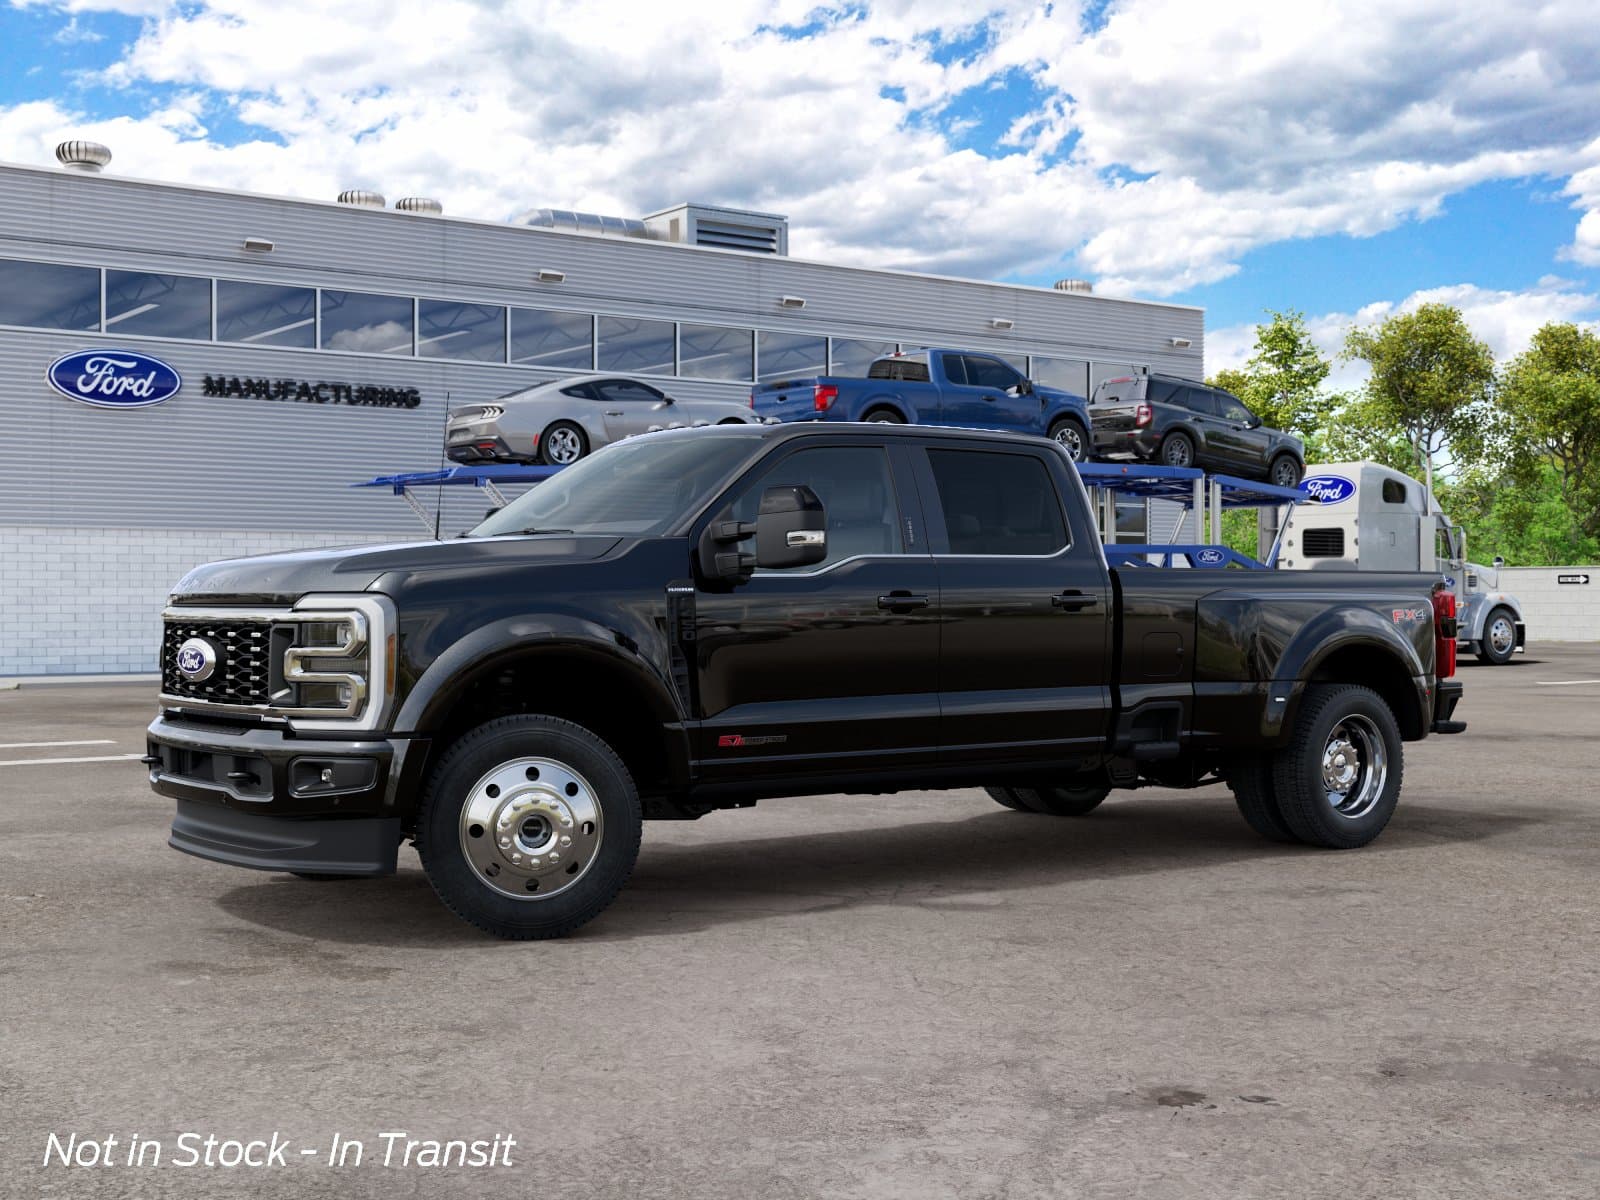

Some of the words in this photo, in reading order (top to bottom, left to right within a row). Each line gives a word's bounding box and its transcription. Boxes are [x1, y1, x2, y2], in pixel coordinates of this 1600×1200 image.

[76, 356, 157, 398] Ford
[201, 373, 421, 409] MANUFACTURING
[1306, 479, 1343, 500] Ford
[1392, 608, 1425, 624] FX4
[182, 649, 201, 669] Ford
